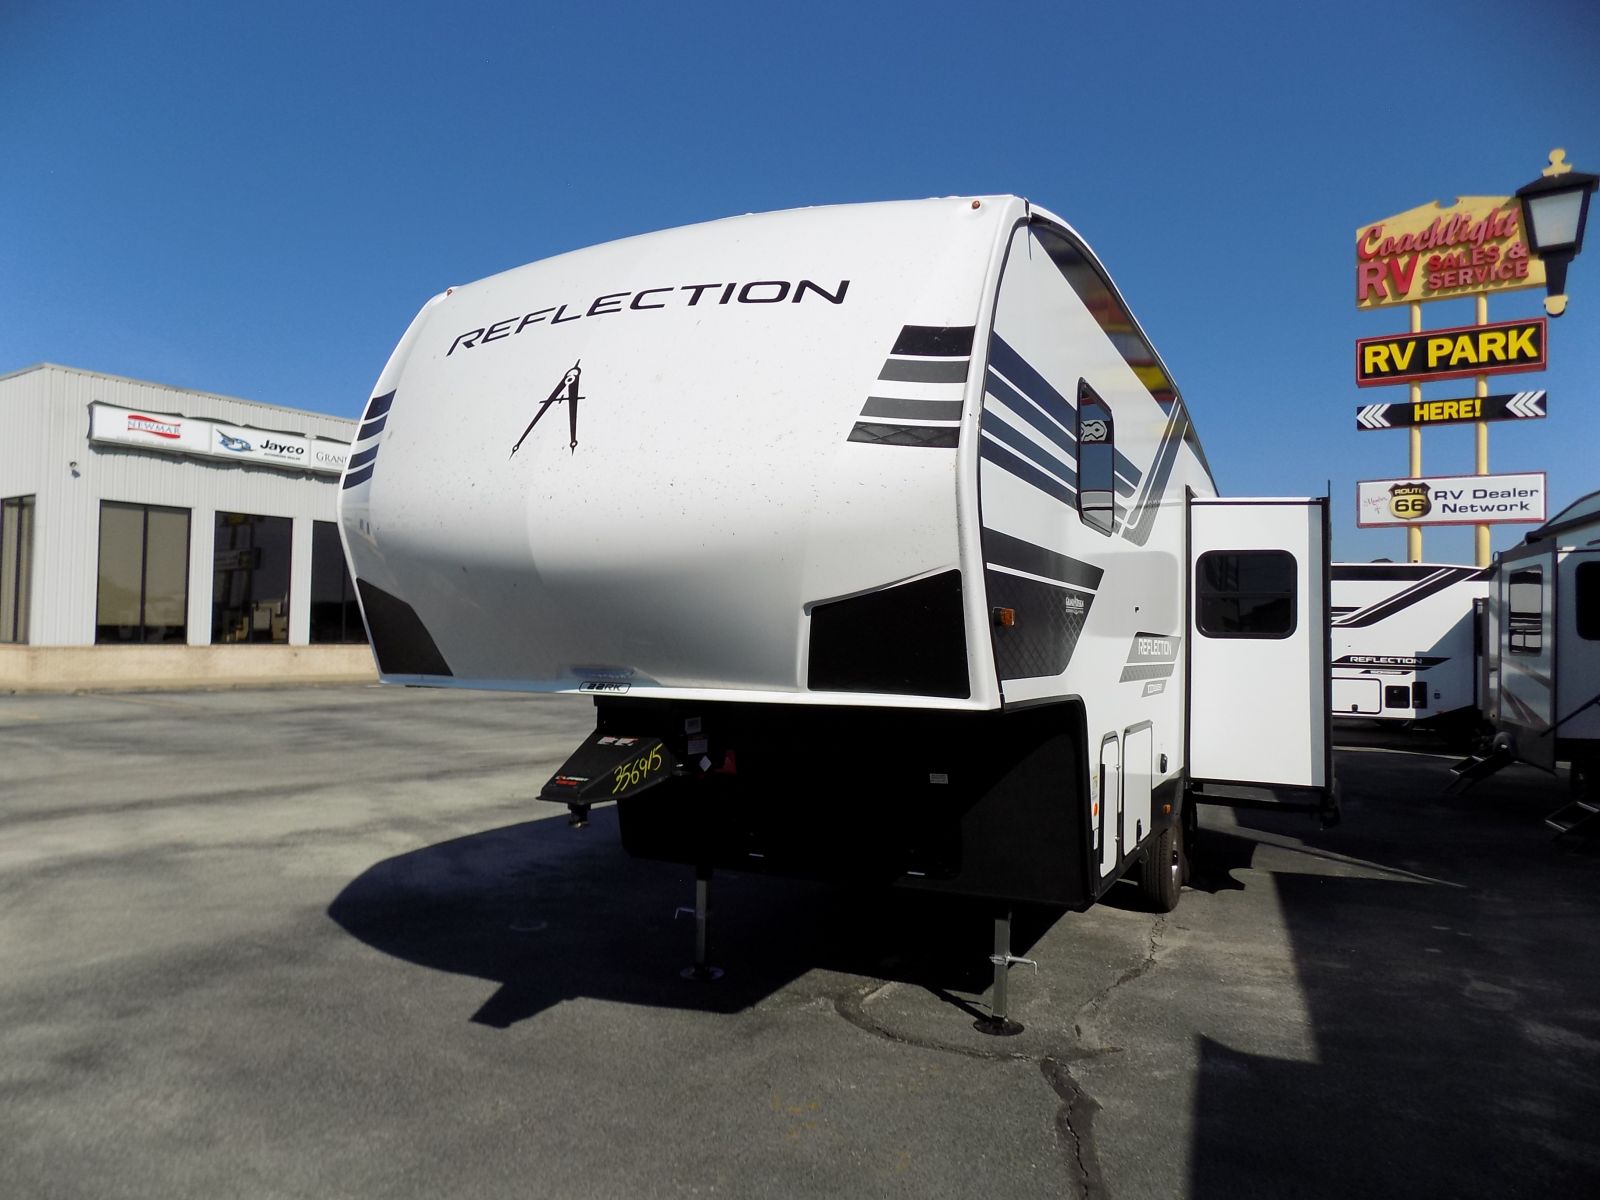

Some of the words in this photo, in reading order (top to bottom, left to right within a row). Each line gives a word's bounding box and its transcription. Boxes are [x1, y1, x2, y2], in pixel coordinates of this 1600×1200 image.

[1357, 207, 1519, 260] Coachlight
[1428, 244, 1500, 272] SALES
[1509, 241, 1528, 259] &
[1357, 254, 1420, 300] RV
[1428, 259, 1529, 290] SERVICE
[446, 279, 850, 357] REFLECTION
[1364, 341, 1416, 374] RV
[1427, 327, 1539, 368] PARK
[1413, 398, 1482, 422] HERE!
[260, 439, 305, 455] Jayco
[1394, 498, 1426, 513] 66
[1434, 489, 1464, 501] RV
[1473, 487, 1539, 500] Dealer
[1441, 502, 1531, 514] Network
[1350, 656, 1423, 665] REFLECTION
[612, 743, 664, 794] 356915
